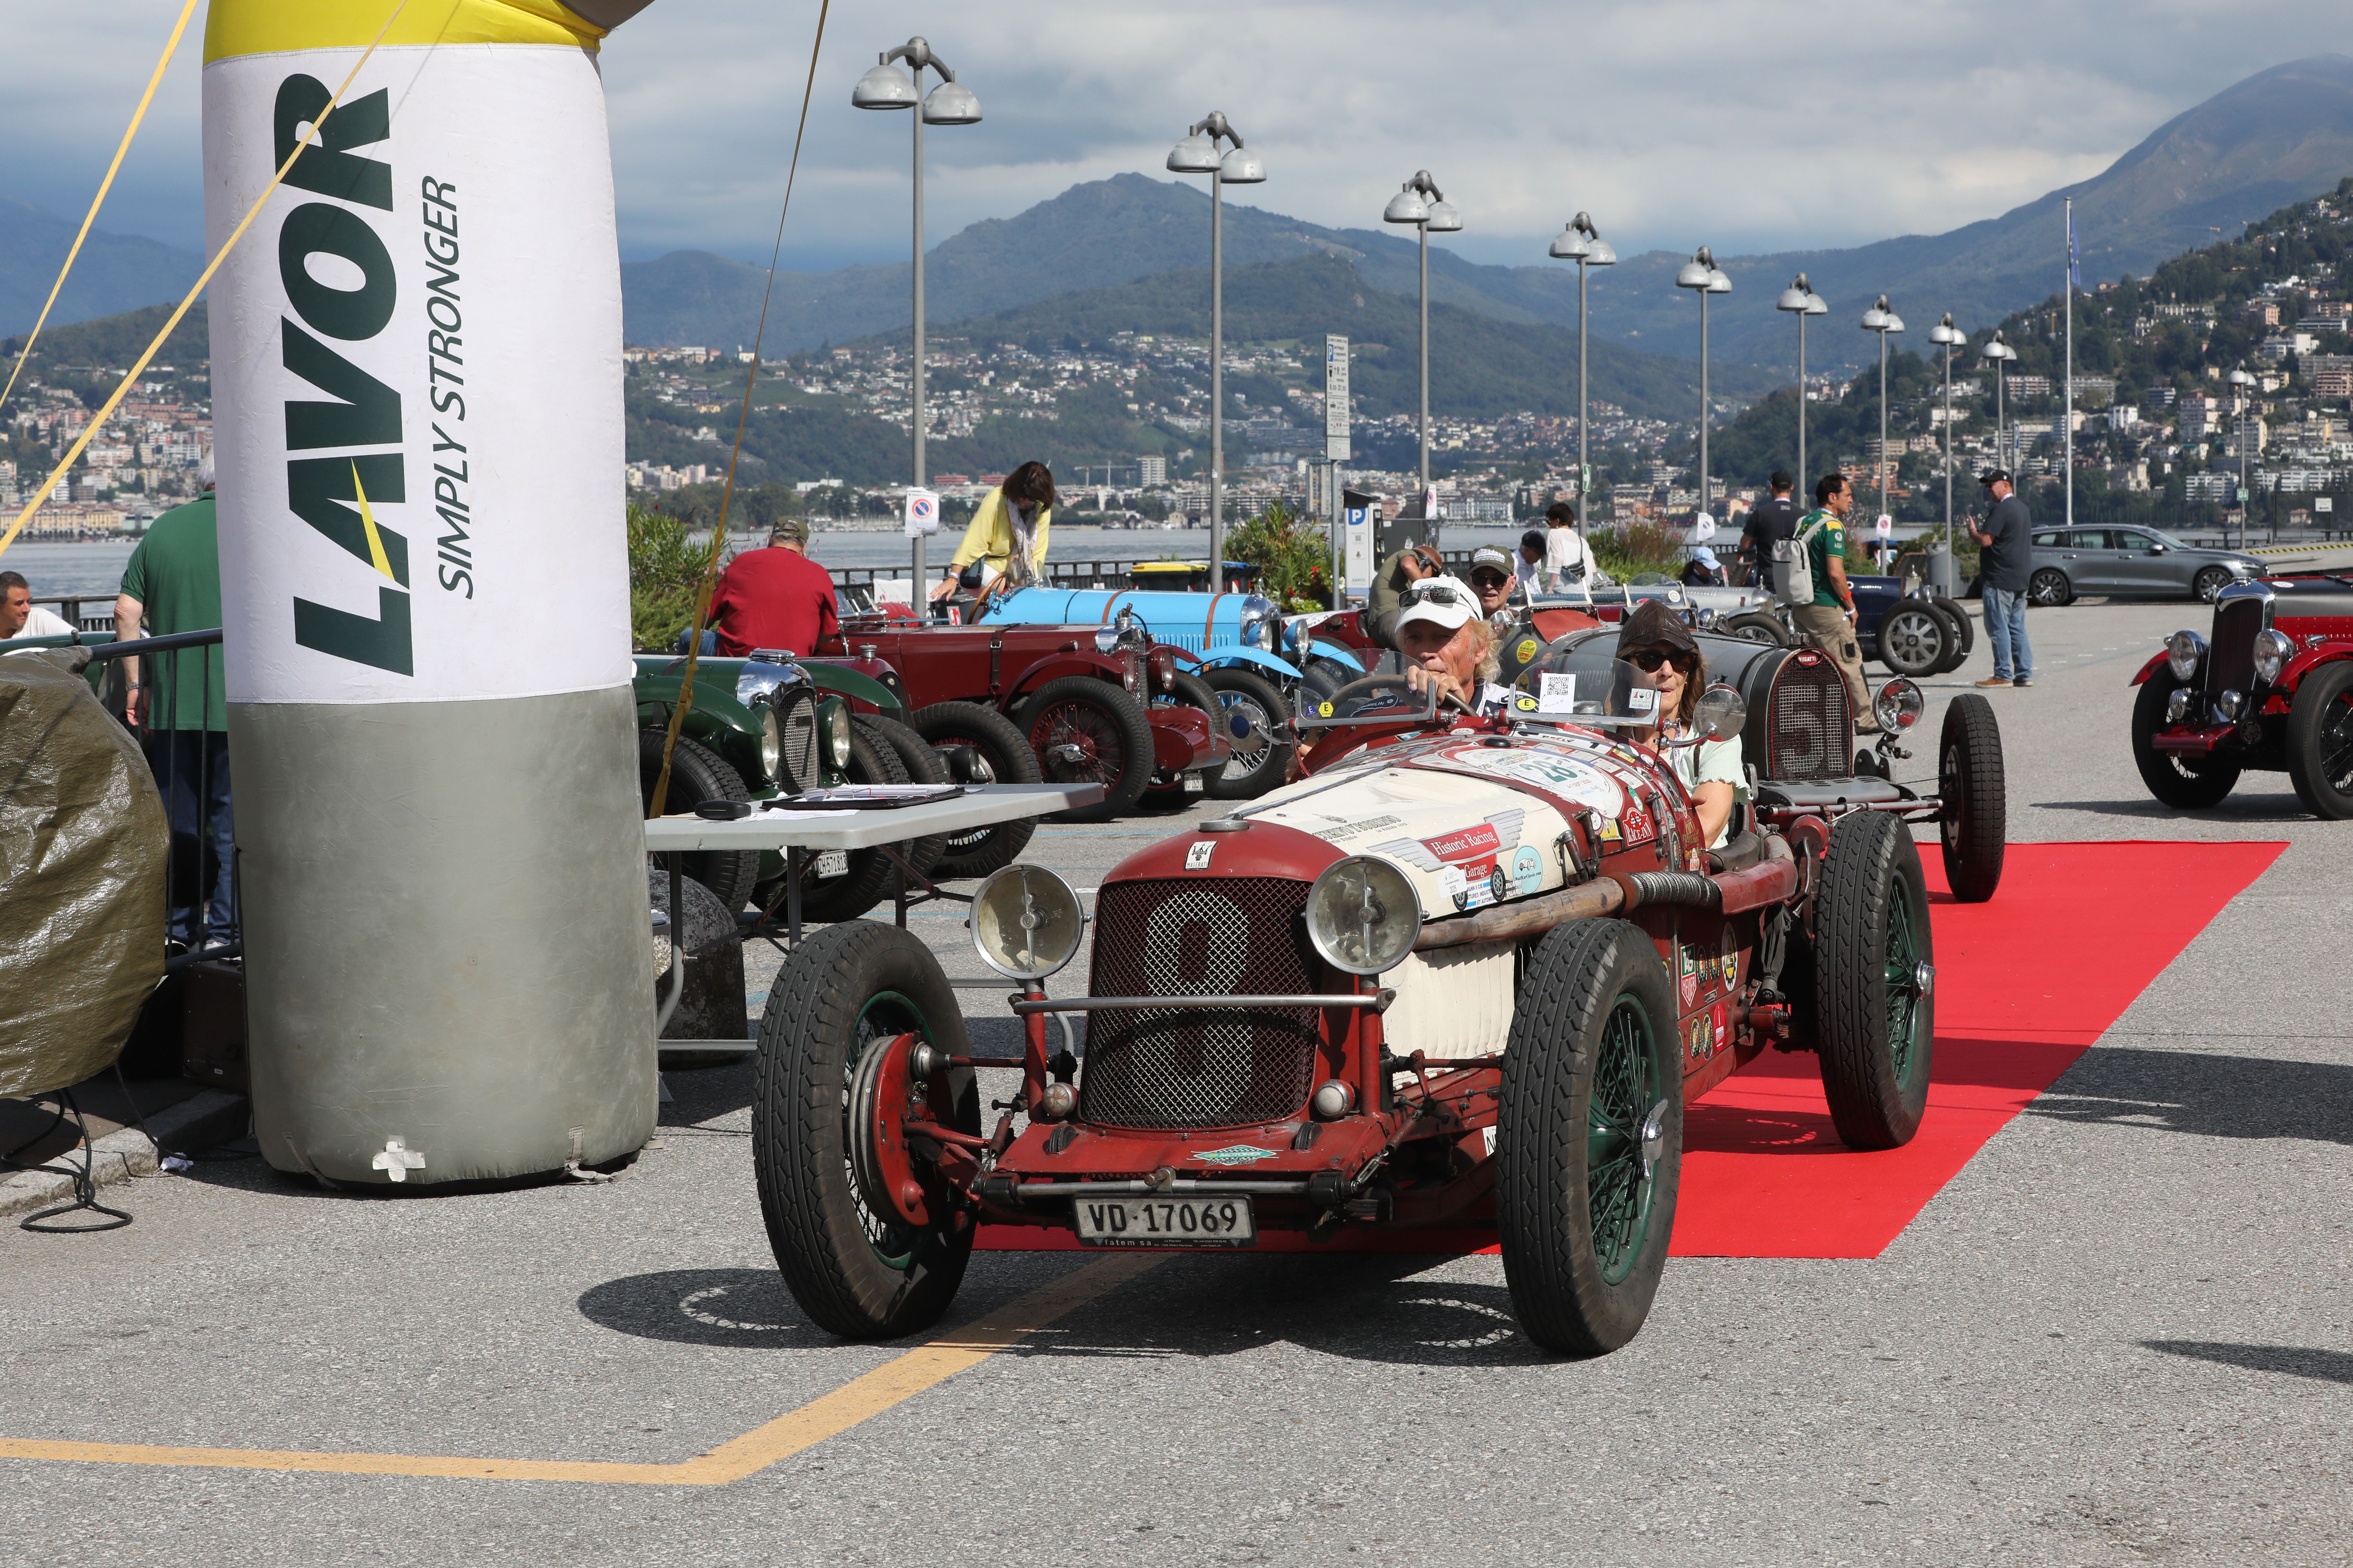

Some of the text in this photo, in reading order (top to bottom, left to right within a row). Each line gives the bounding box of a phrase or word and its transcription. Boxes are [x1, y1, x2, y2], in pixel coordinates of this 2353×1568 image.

[274, 73, 414, 678] LAVOR
[422, 175, 474, 601] SIMPLY STRONGER
[1308, 705, 1313, 714] E
[1324, 704, 1329, 712] E
[1430, 831, 1498, 855] Historic Racing
[1464, 863, 1487, 878] Garage
[1683, 948, 1693, 974] TAG
[1682, 976, 1695, 1003] HEUER
